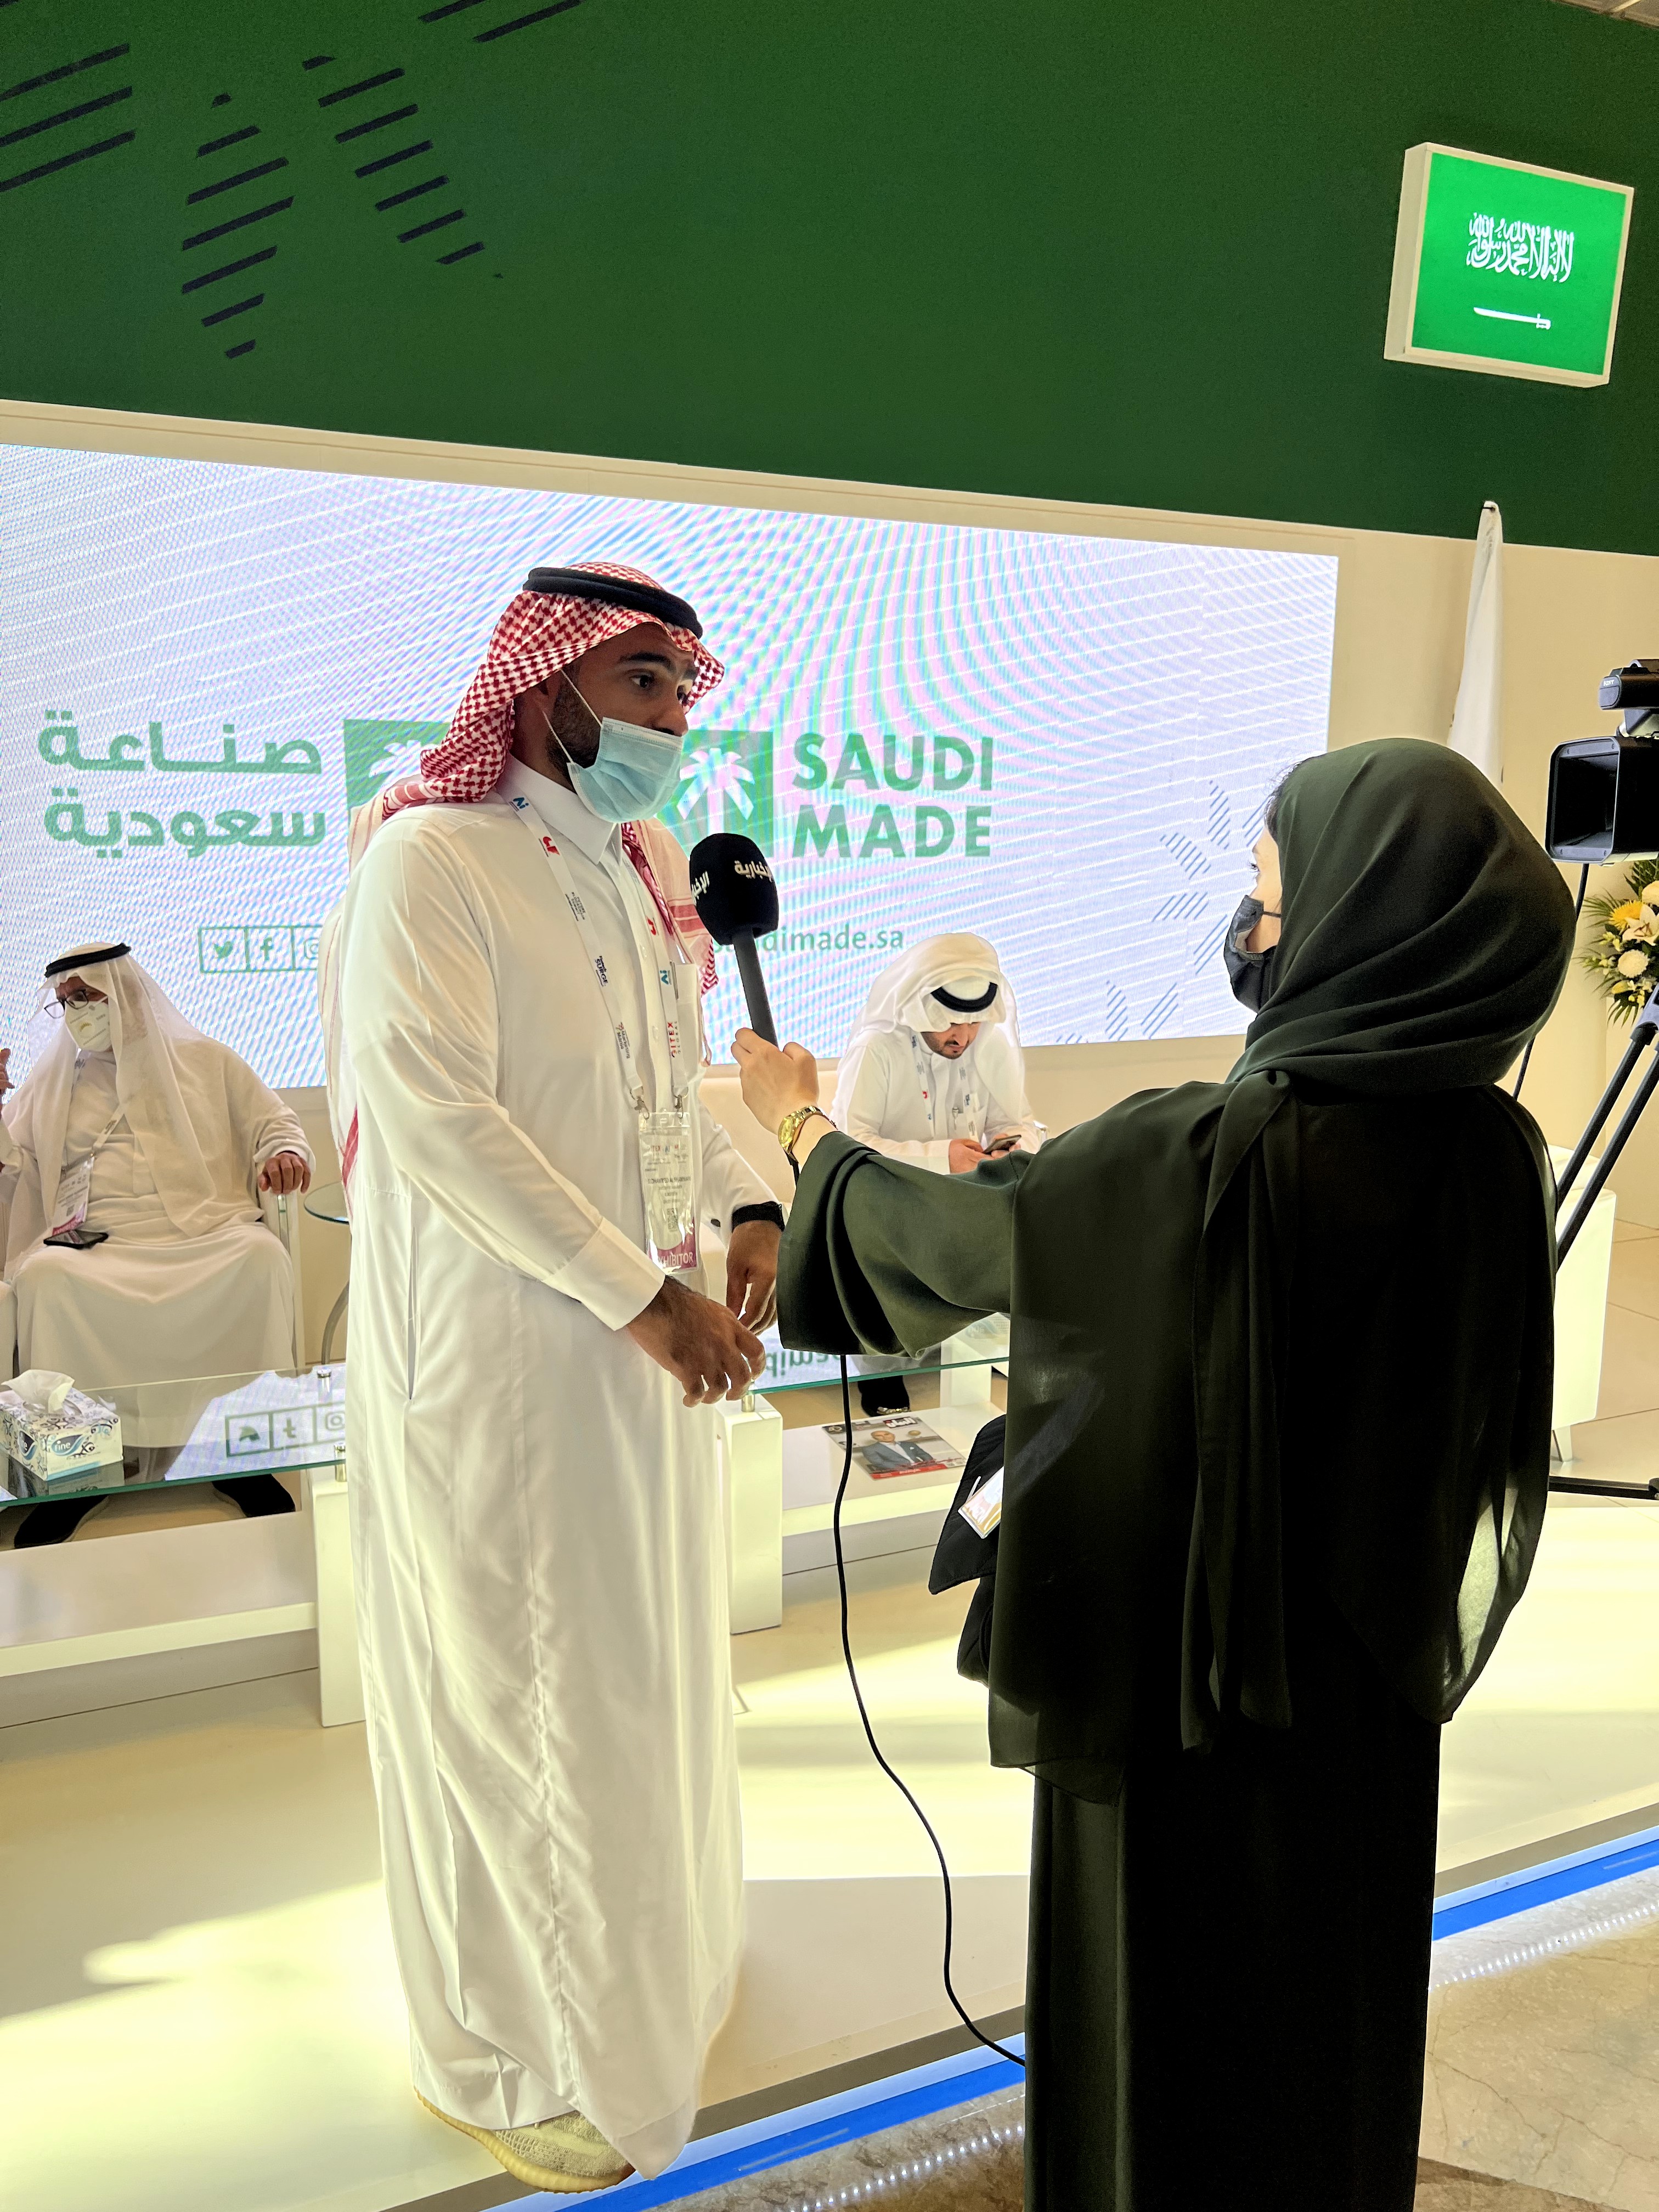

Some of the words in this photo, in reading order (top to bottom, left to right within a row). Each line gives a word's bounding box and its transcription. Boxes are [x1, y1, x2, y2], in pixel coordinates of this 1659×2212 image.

[38, 709, 322, 775] صناعة
[792, 733, 994, 791] SAUDI
[43, 787, 326, 858] سعودية
[792, 805, 991, 857] MADE
[595, 958, 608, 984] SURGE
